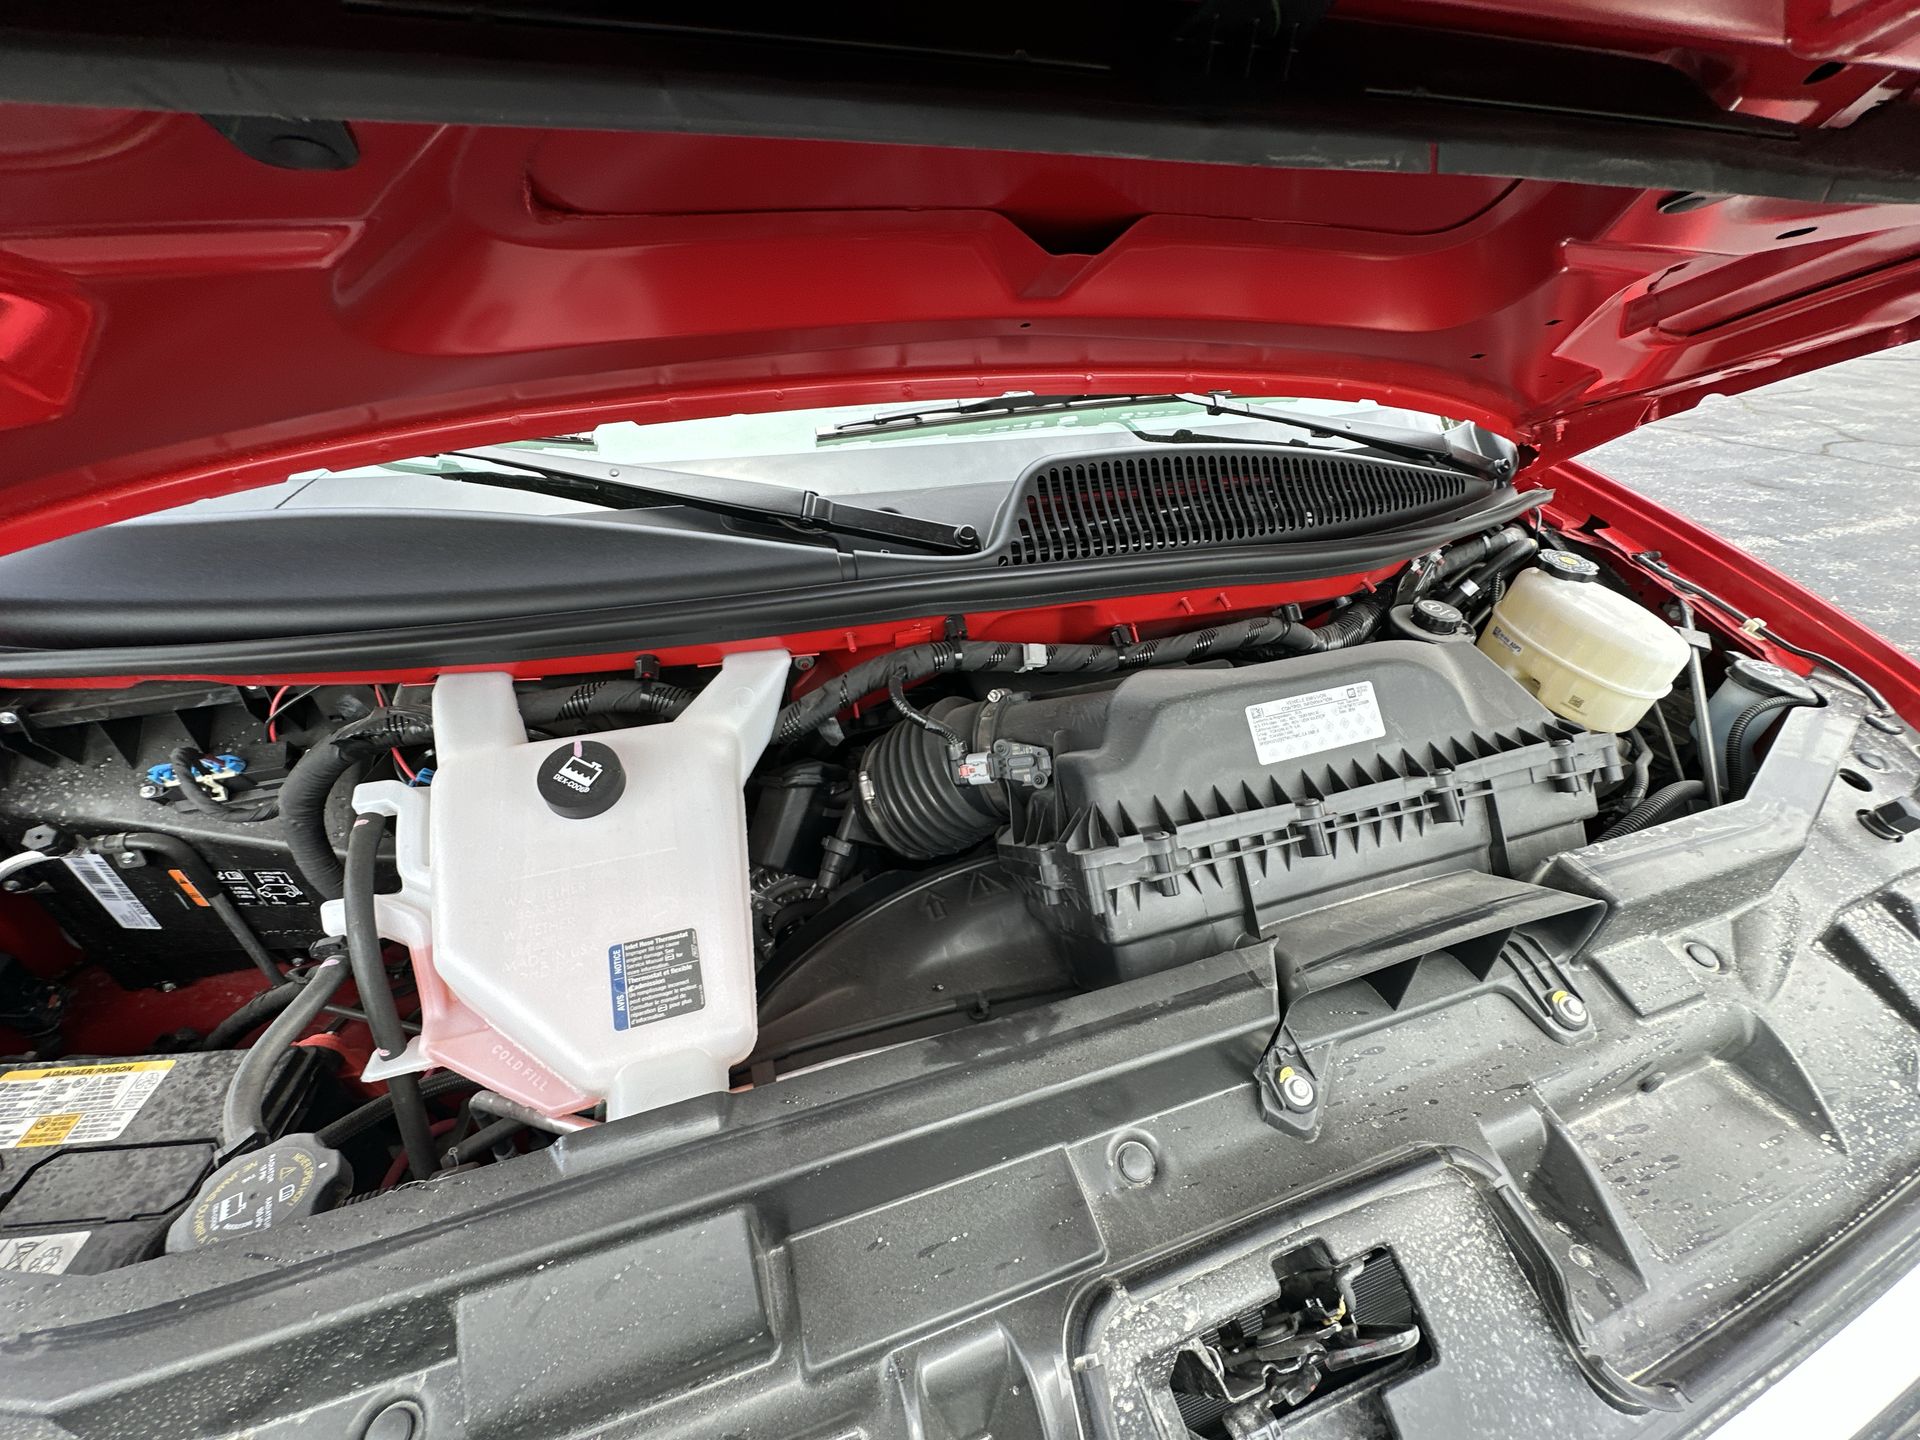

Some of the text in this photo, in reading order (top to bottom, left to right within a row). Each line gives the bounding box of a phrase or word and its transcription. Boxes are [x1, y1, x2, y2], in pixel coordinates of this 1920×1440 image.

[624, 942, 639, 951] Inlet
[639, 939, 654, 947] Hose
[655, 931, 689, 944] Thermostat
[613, 949, 621, 975] NOTICE
[645, 957, 664, 965] Manual
[627, 971, 663, 984] Thermostat
[670, 964, 693, 974] flexible
[616, 994, 626, 1011] AVIS
[491, 1044, 548, 1091] COLD FILL
[266, 1153, 276, 1184] RADIATOR
[291, 1152, 312, 1169] NEVER
[299, 1166, 313, 1186] OPEN
